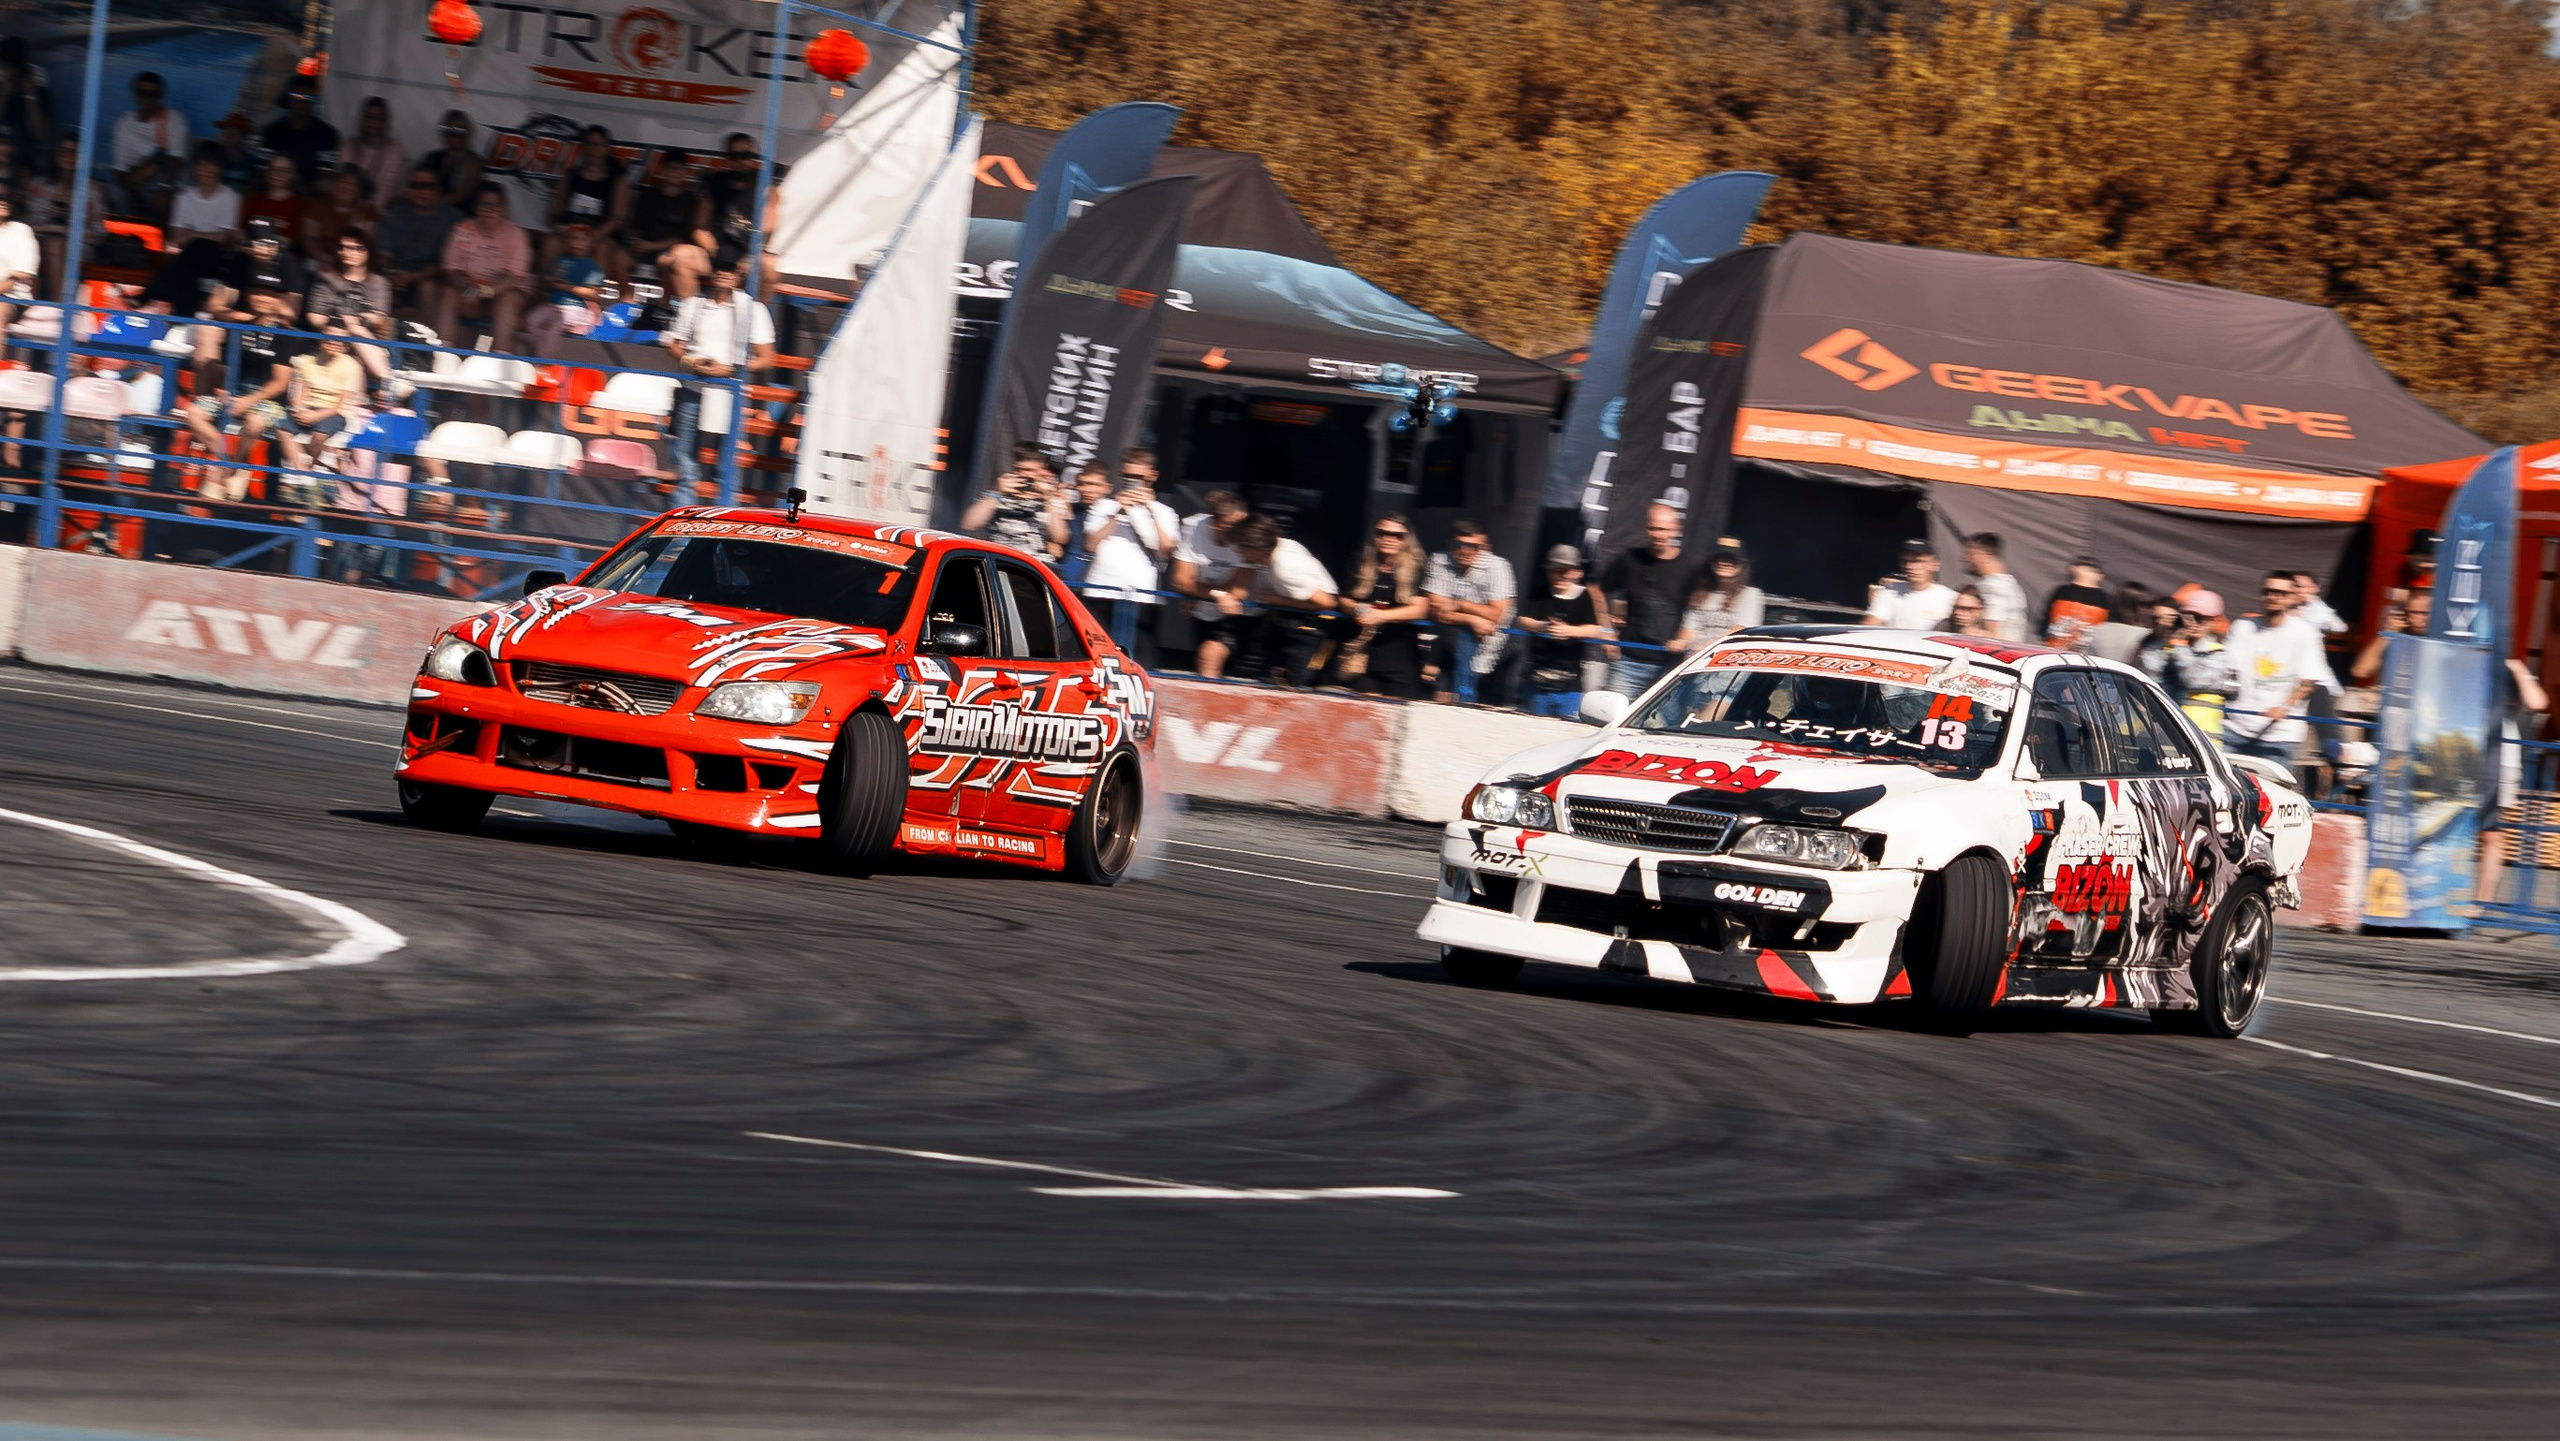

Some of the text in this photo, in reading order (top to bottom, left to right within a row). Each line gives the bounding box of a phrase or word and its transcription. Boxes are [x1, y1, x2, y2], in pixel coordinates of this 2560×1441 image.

[1929, 362, 2356, 440] GEEKVAPE
[1966, 404, 2252, 454] ДЫМА НЕТ
[664, 521, 744, 533] DRIFT
[737, 524, 803, 540] LETO
[878, 571, 901, 594] 1
[1718, 652, 1806, 665] DRIFT
[1799, 656, 1871, 673] LETO
[1926, 693, 1974, 722] 14
[921, 699, 1099, 757] SIBIRMOTORS
[1162, 715, 1284, 773] VL
[1920, 718, 1968, 750] 13
[1584, 749, 1782, 791] BIZON
[909, 827, 1035, 853] FROM CILIAN TO RACING
[2052, 864, 2133, 913] BIZON
